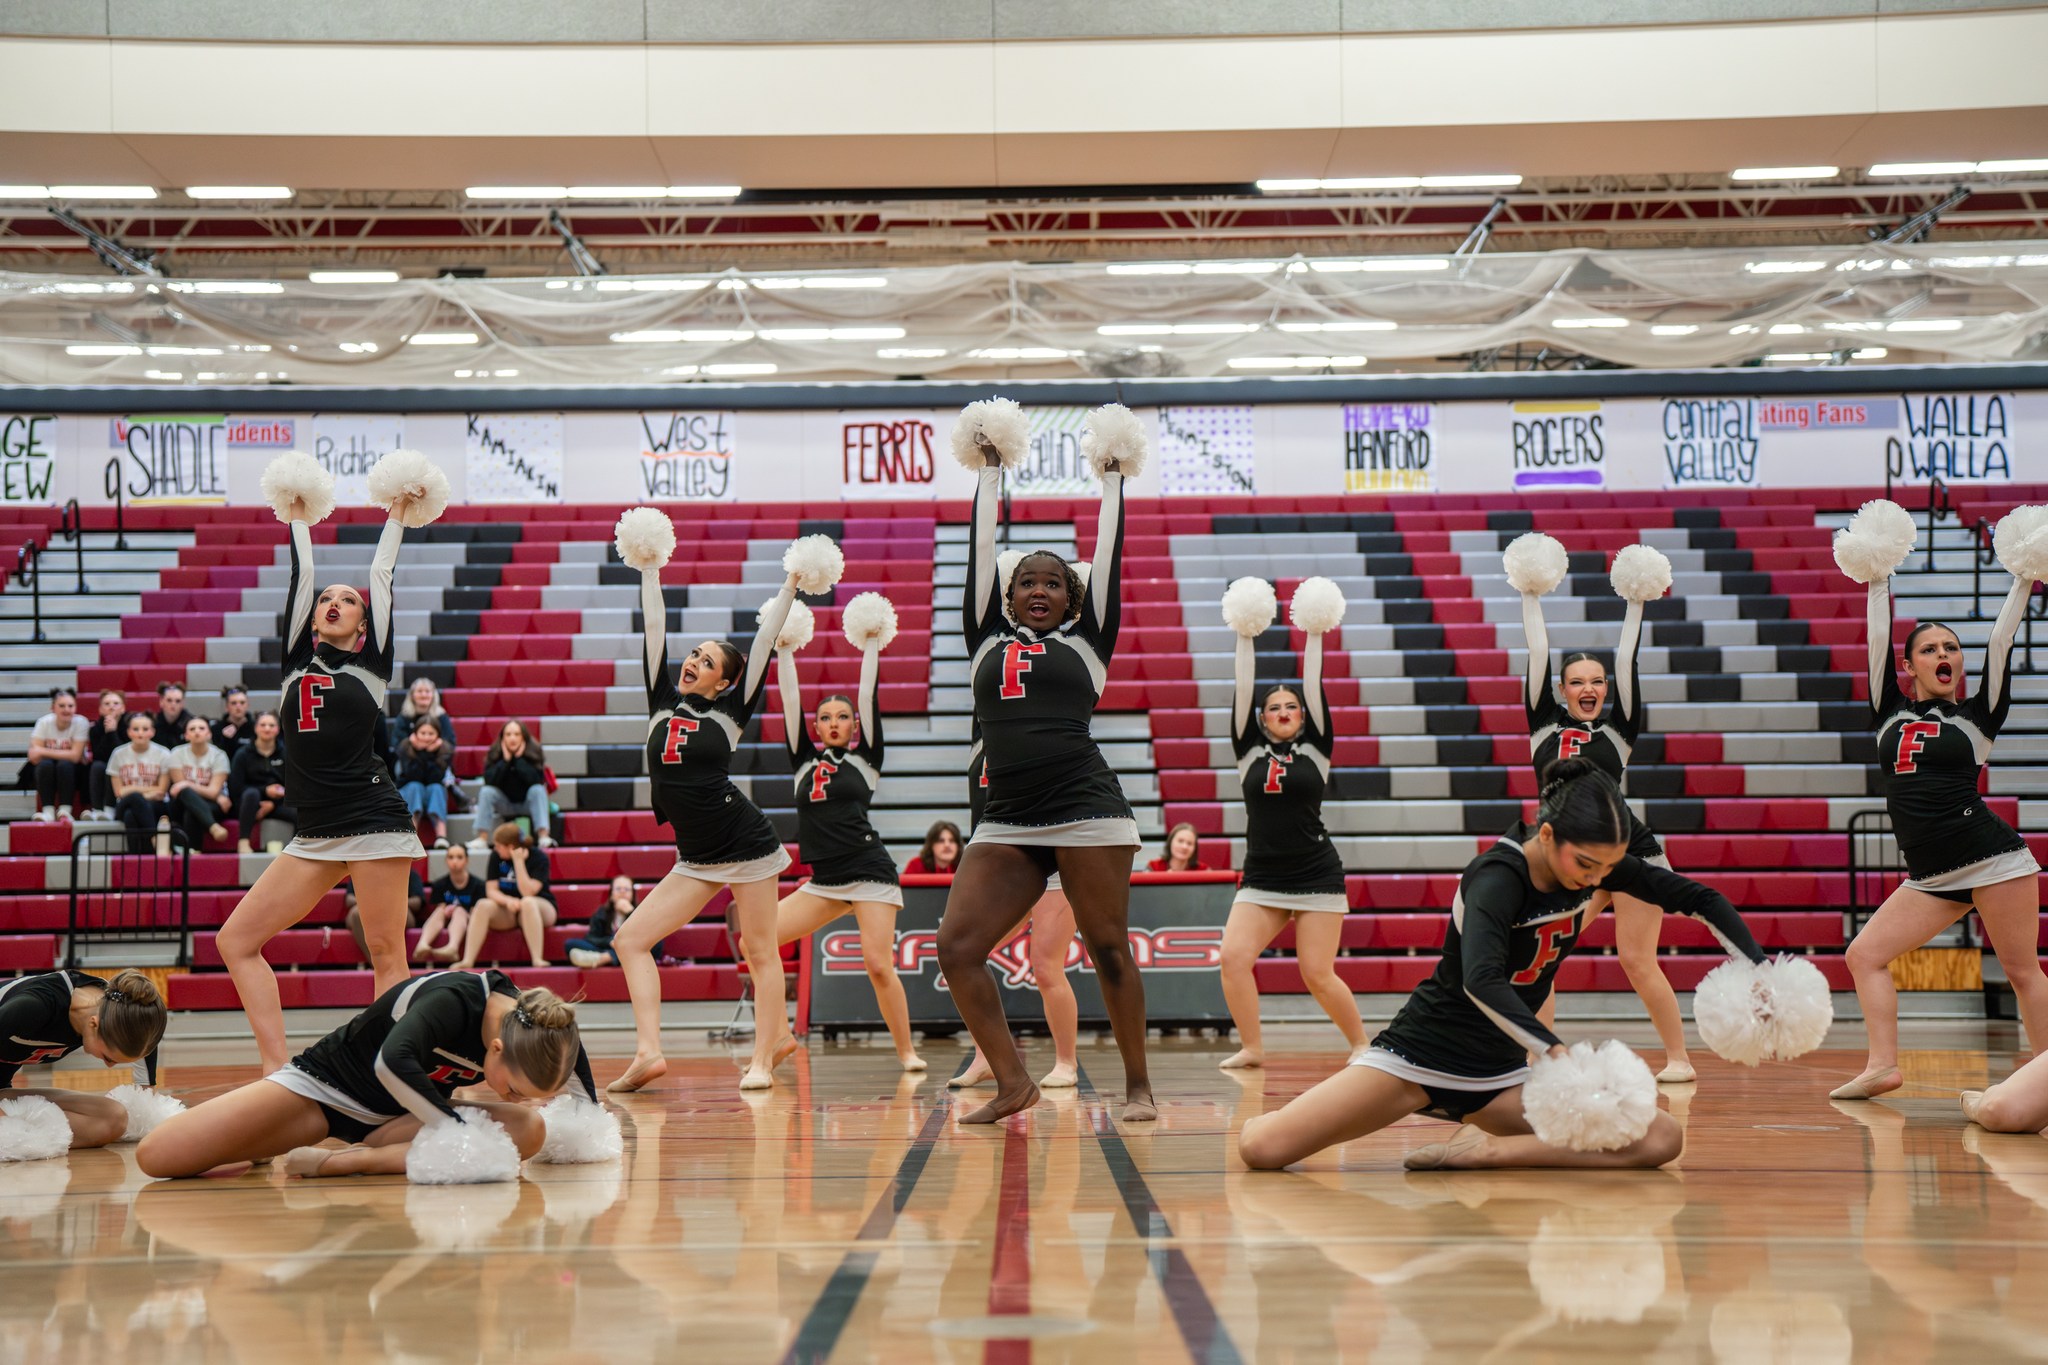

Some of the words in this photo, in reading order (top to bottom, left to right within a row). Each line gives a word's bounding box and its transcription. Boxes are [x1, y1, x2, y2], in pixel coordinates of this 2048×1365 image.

[0, 415, 54, 458] GE
[640, 410, 728, 456] West
[1758, 402, 1809, 429] iting
[1817, 401, 1867, 424] Fans
[1903, 394, 2007, 438] WALLA
[127, 423, 227, 498] SHADLE
[466, 413, 558, 498] KAMIAKIN
[843, 420, 934, 484] FERRIS
[1158, 406, 1253, 491] HERMISTON
[1345, 429, 1430, 470] HANFORD
[1513, 415, 1604, 468] ROGERS
[1908, 439, 2010, 479] WALLA
[0, 460, 53, 500] EW
[640, 458, 729, 498] Valley
[999, 640, 1047, 700] F
[297, 673, 336, 732] F
[661, 716, 700, 765] F
[1557, 727, 1592, 760] F
[1893, 720, 1942, 775] F
[809, 760, 838, 803] F
[1263, 752, 1294, 794] F
[1509, 916, 1576, 986] F
